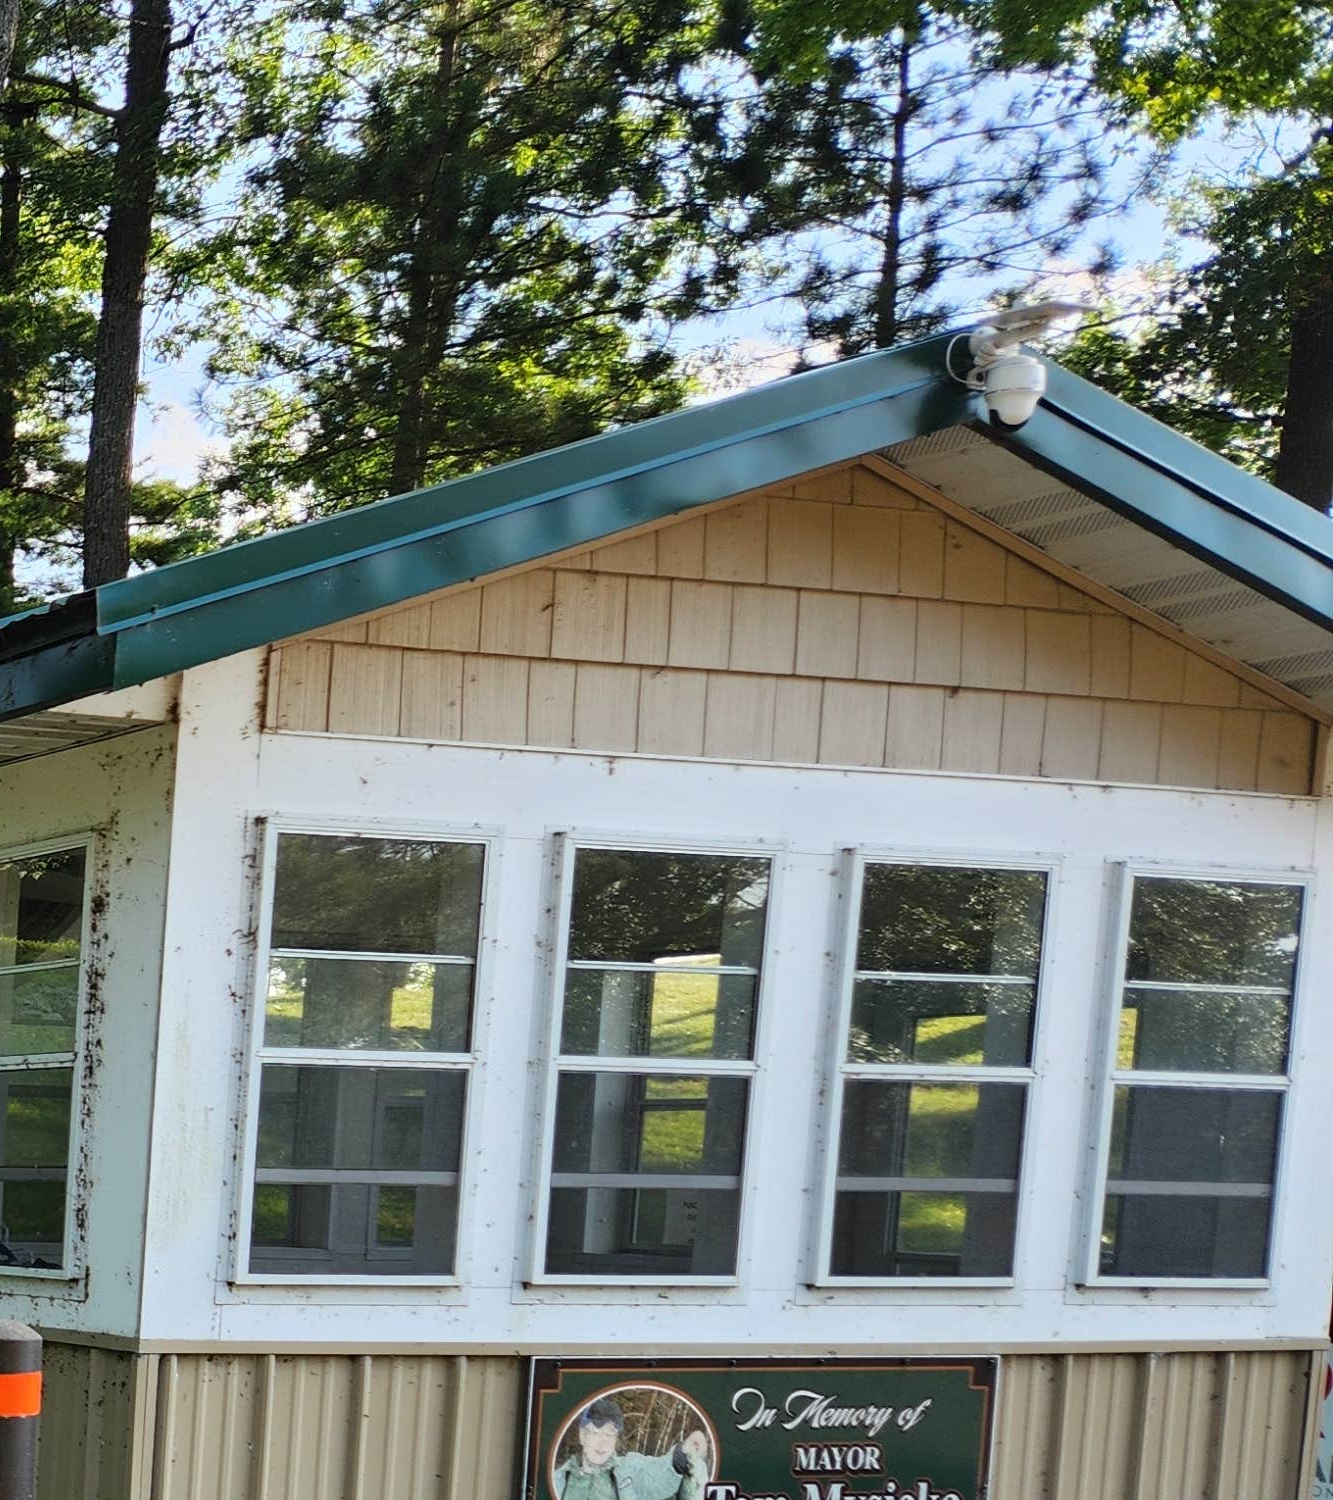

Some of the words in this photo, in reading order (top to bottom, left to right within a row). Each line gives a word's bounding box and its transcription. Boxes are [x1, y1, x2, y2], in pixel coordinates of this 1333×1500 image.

[731, 1387, 778, 1432] In
[781, 1389, 893, 1438] Memory
[895, 1398, 933, 1432] of
[794, 1445, 882, 1473] MAYOR
